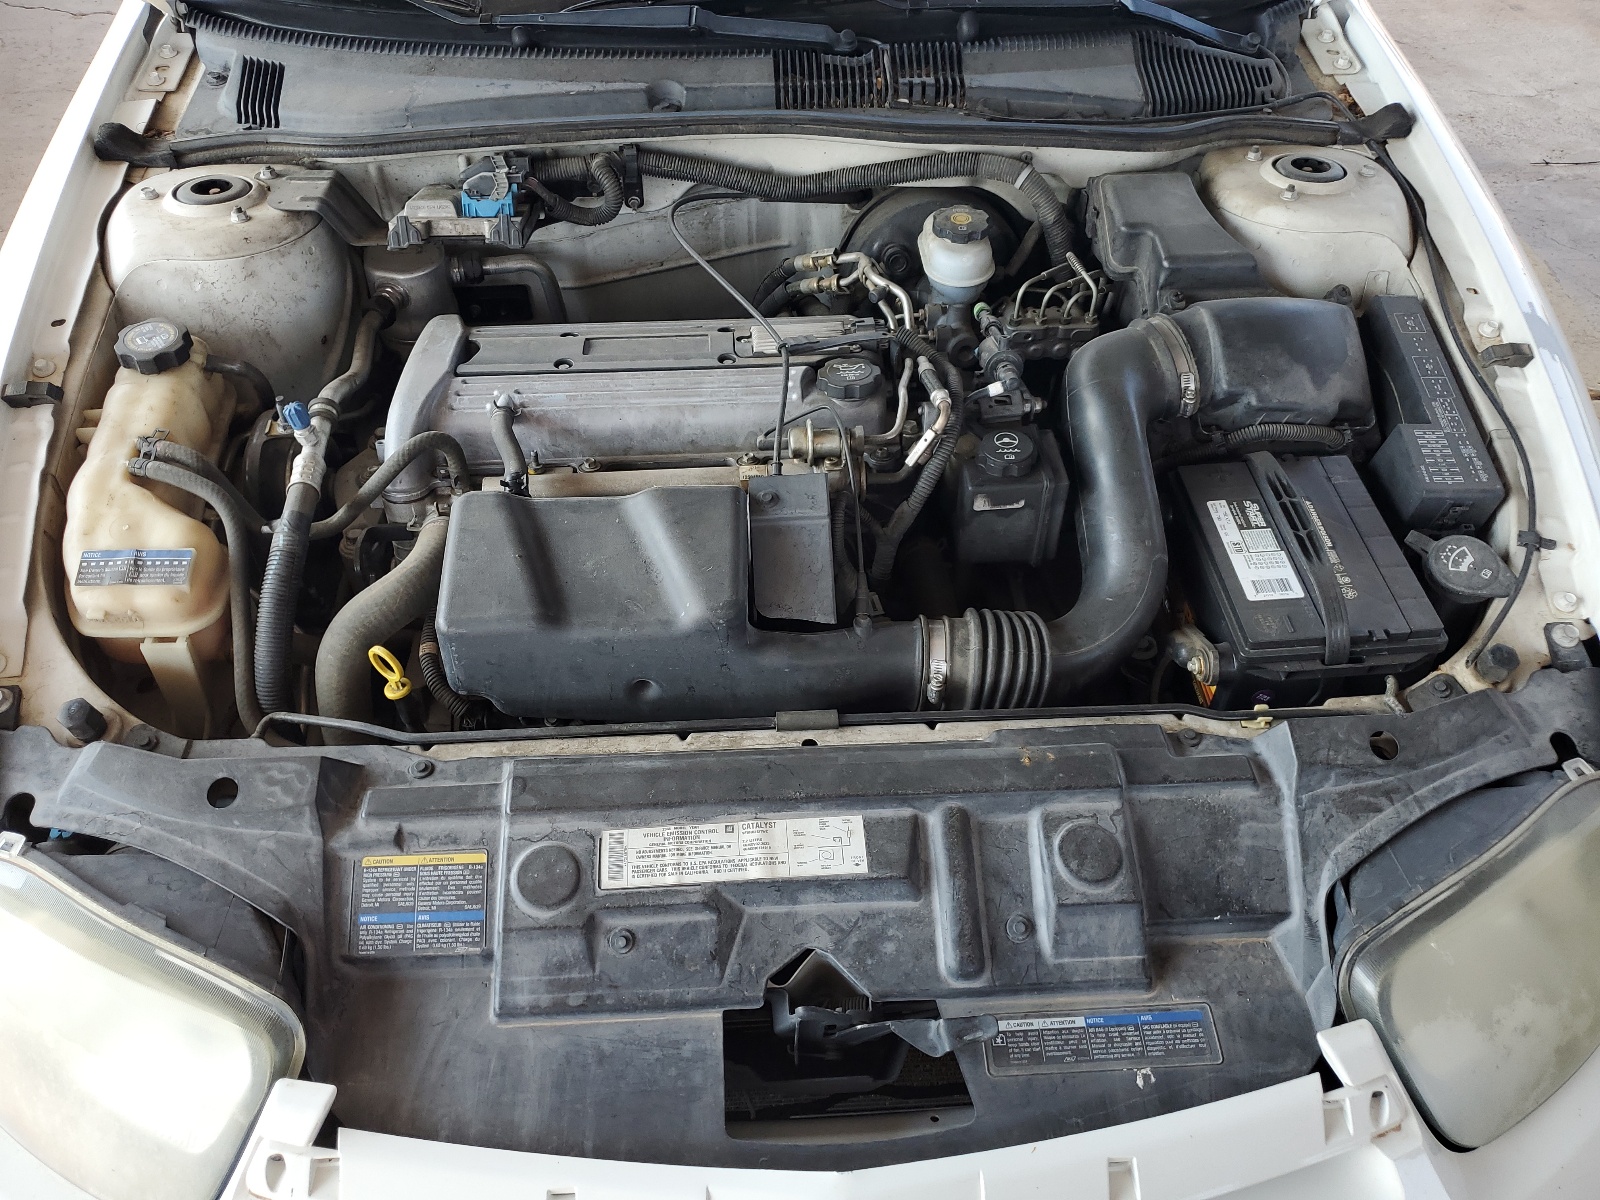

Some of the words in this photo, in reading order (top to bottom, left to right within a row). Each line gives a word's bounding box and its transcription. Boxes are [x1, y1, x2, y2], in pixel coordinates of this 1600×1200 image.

[1243, 501, 1260, 527] START
[1253, 504, 1266, 526] SUPER
[742, 821, 776, 830] CATALYST
